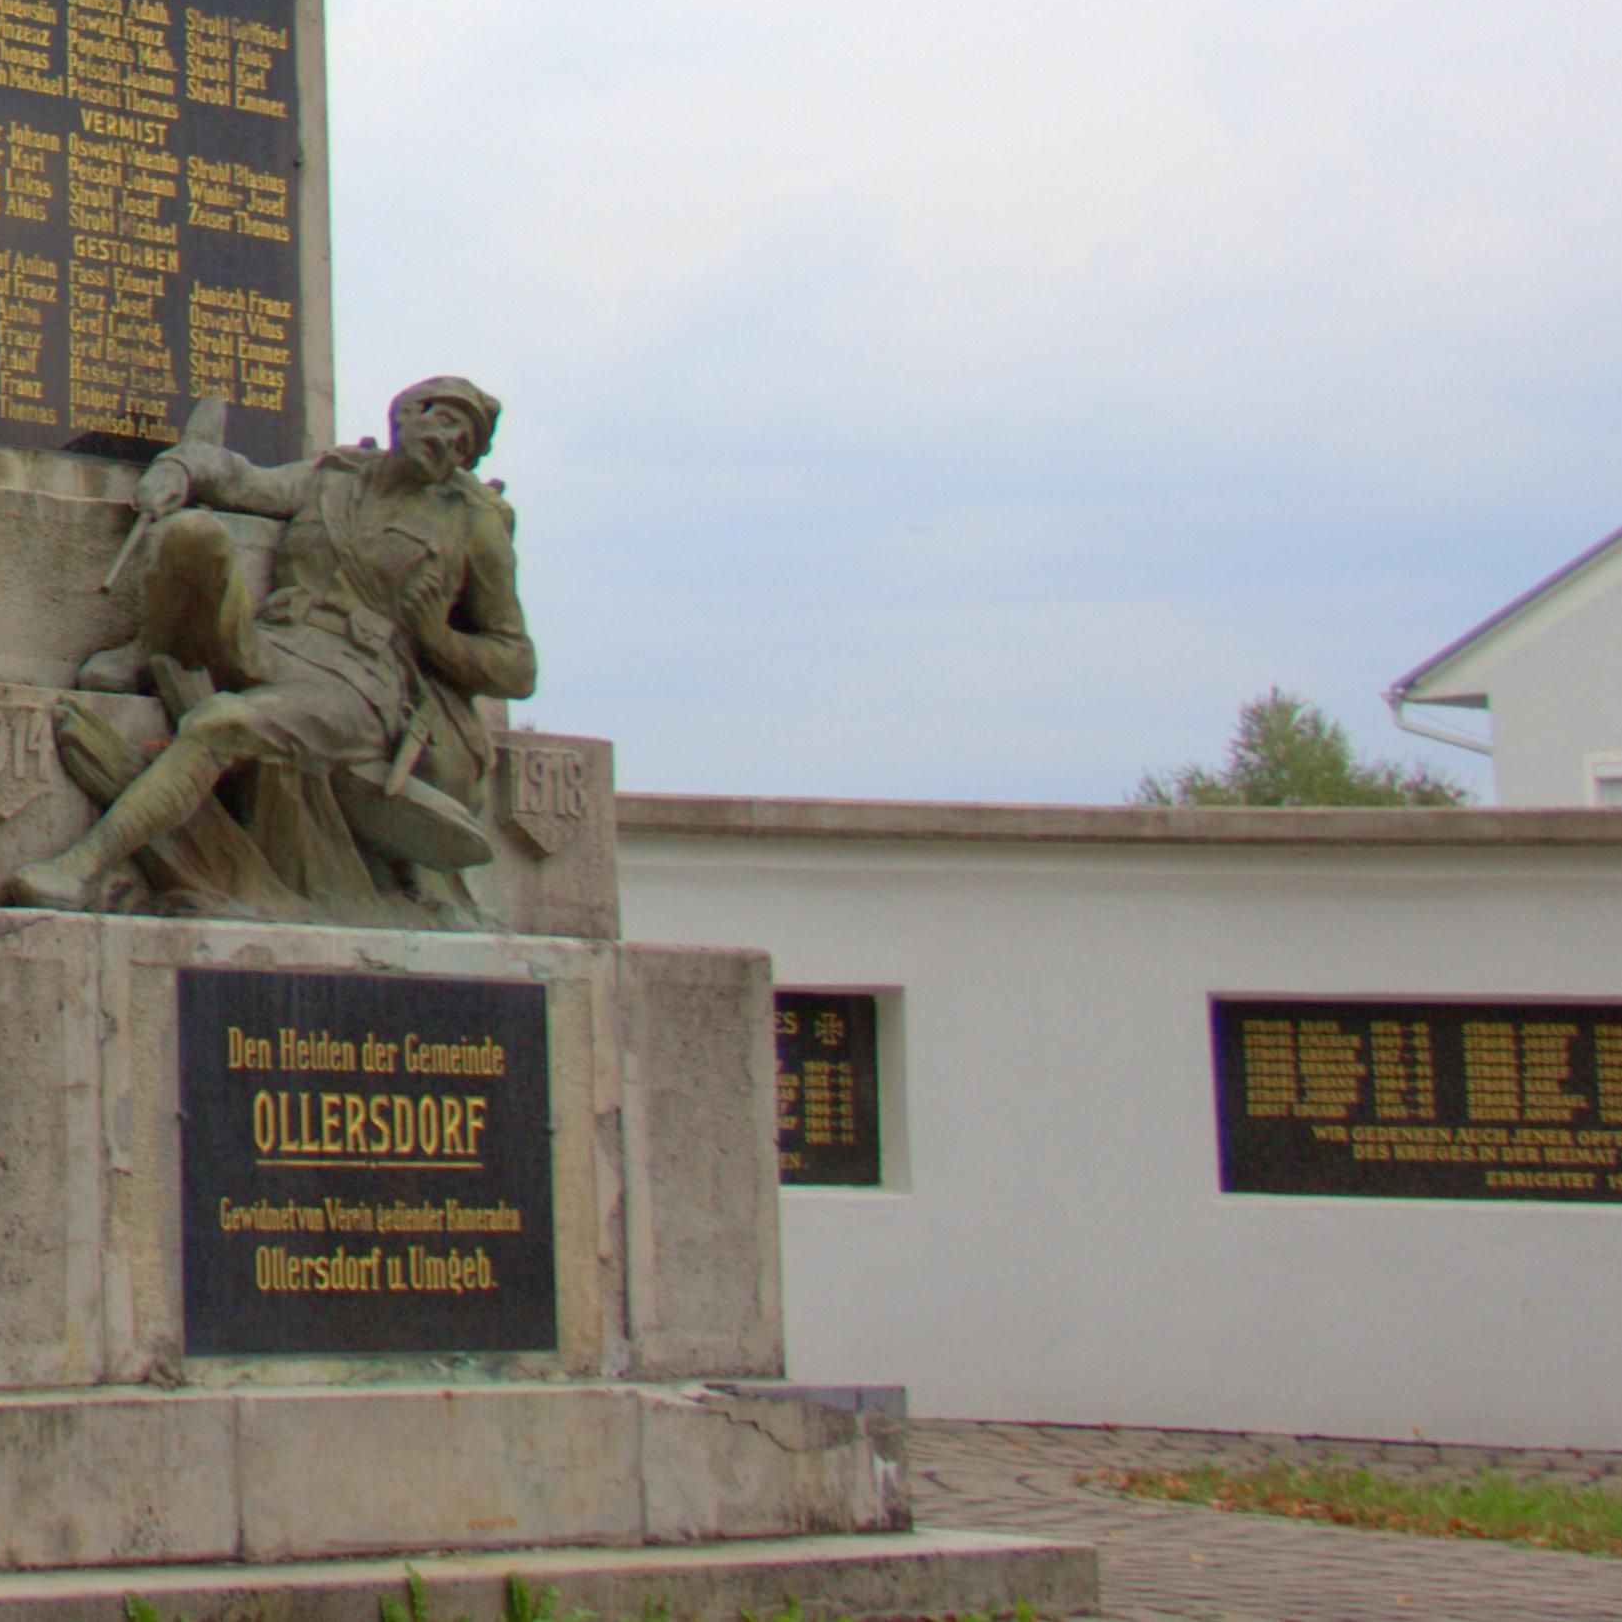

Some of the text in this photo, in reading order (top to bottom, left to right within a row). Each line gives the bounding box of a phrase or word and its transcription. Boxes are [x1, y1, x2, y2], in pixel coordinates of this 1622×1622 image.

[68, 6, 165, 46] Oswald Franz
[9, 64, 64, 96] Michael
[124, 65, 175, 96] Johann
[123, 88, 180, 119] Thomas
[6, 120, 61, 152] Johann
[80, 108, 168, 146] VERMIST
[68, 132, 122, 164] Oswald
[5, 168, 52, 198] Lukas
[124, 167, 177, 197] Johann
[118, 189, 160, 218] Josef
[246, 189, 285, 218] Josef
[233, 209, 291, 242] Thomas
[72, 234, 179, 273] GESTORBEN
[13, 274, 57, 303] Franz
[110, 290, 154, 319] Josef
[248, 290, 292, 318] Franz
[69, 308, 104, 335] Graf
[0, 370, 43, 399] Franz
[241, 360, 286, 388] Lukas
[125, 389, 168, 418] Franz
[241, 384, 284, 411] Josef
[514, 748, 587, 818] 1918
[228, 1026, 505, 1076] Den Helden der Gemeinde
[253, 1089, 487, 1156] OLLERSDORF
[1311, 1126, 1349, 1141] WIR
[1351, 1127, 1453, 1143] GEDENKEN
[1455, 1128, 1509, 1145] AUCH
[1510, 1129, 1573, 1146] JENER
[1353, 1144, 1391, 1160] DES
[1394, 1144, 1477, 1162] KRIEGES
[1501, 1147, 1542, 1164] DER
[1543, 1148, 1618, 1166] HEIMAT
[1485, 1171, 1596, 1190] ERRICHTET
[220, 1196, 297, 1232] Gewidmet
[324, 1197, 375, 1232] Verein
[445, 1198, 522, 1233] Kameraden
[256, 1245, 500, 1295] Ollersdorf u. Umgeb.
